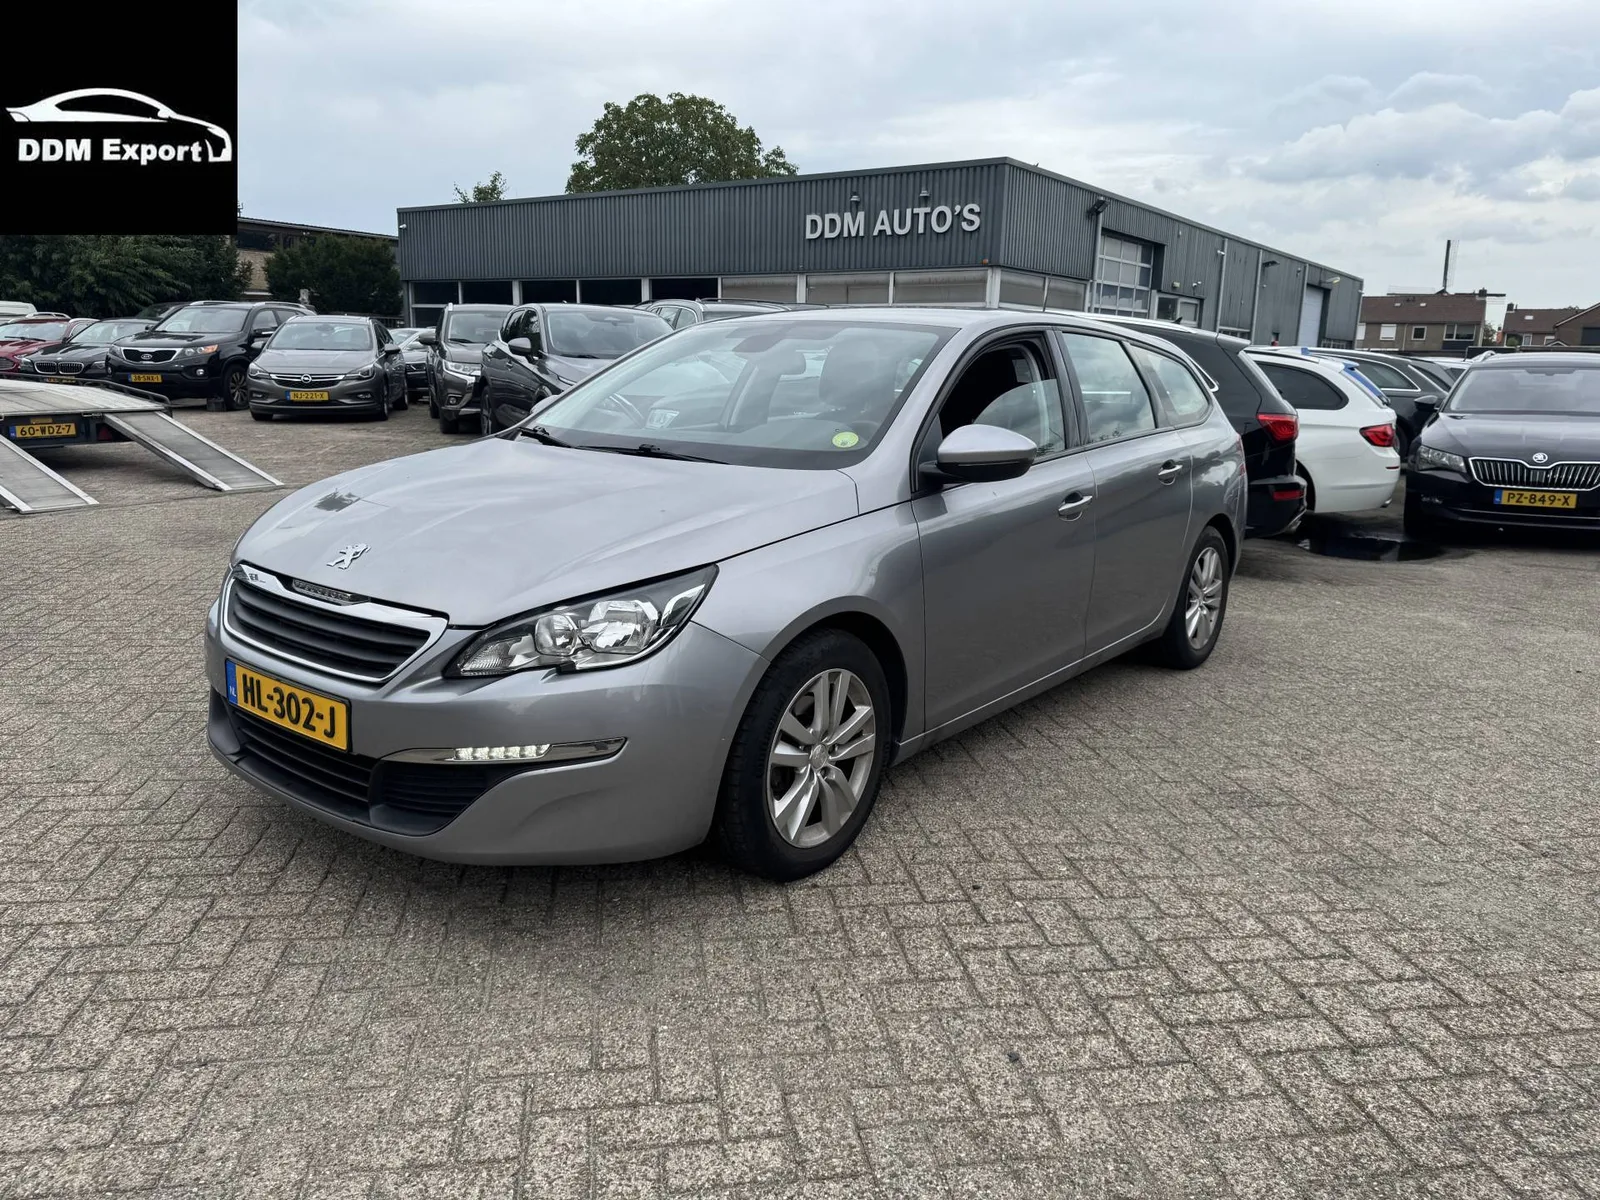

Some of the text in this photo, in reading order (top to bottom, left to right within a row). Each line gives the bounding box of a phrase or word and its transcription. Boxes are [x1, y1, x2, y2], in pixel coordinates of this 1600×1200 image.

[805, 203, 981, 240] DDM AUTO'S
[20, 424, 71, 436] 60-WDZ-7
[1507, 492, 1571, 506] PZ-849-X
[242, 673, 336, 739] HL-302-J
